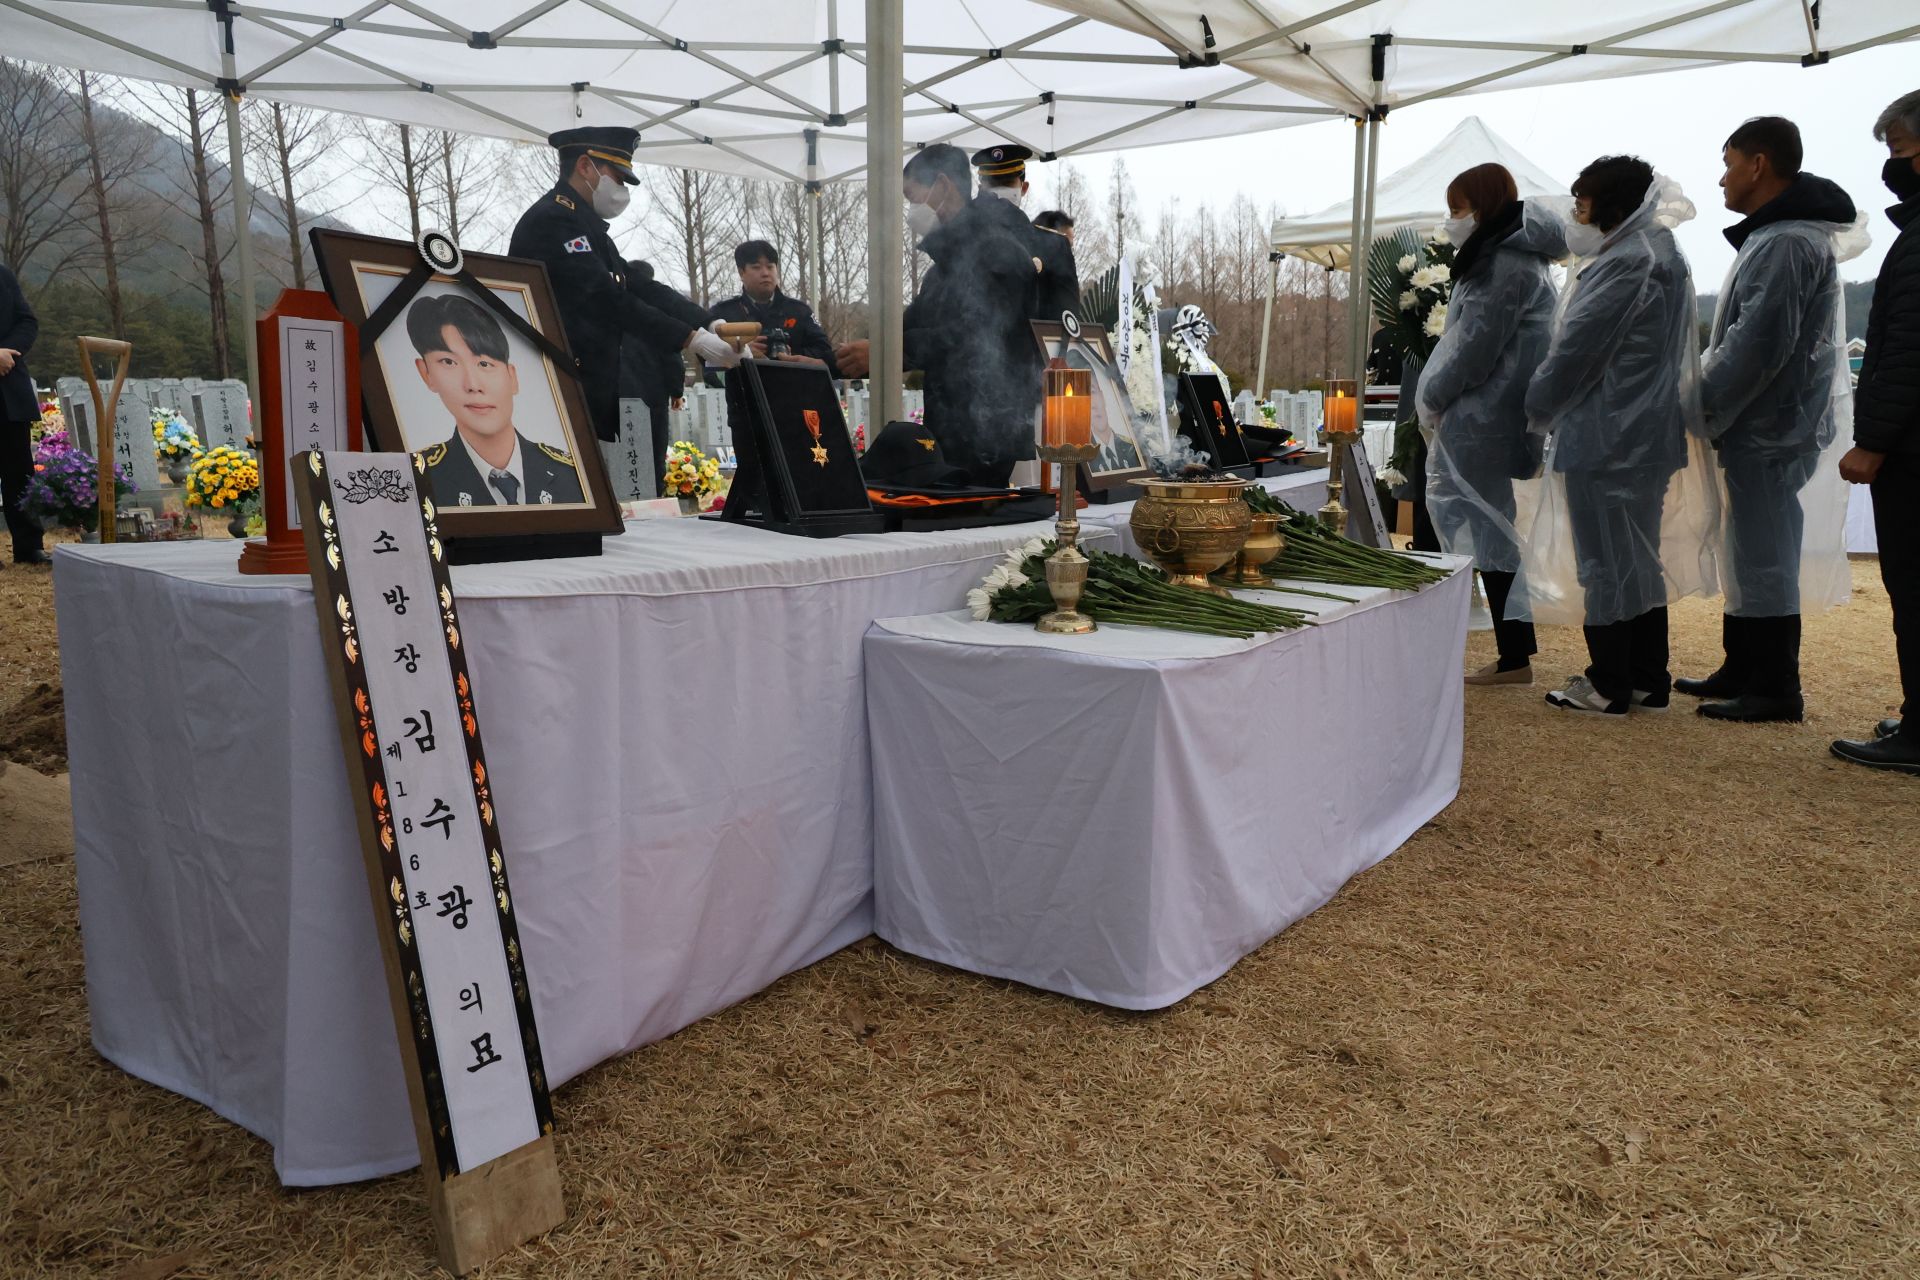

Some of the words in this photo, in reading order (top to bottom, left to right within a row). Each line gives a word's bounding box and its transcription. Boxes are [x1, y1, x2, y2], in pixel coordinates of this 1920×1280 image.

[309, 422, 321, 451] 소방
[627, 449, 641, 500] 장진수
[372, 530, 422, 674] 소방장
